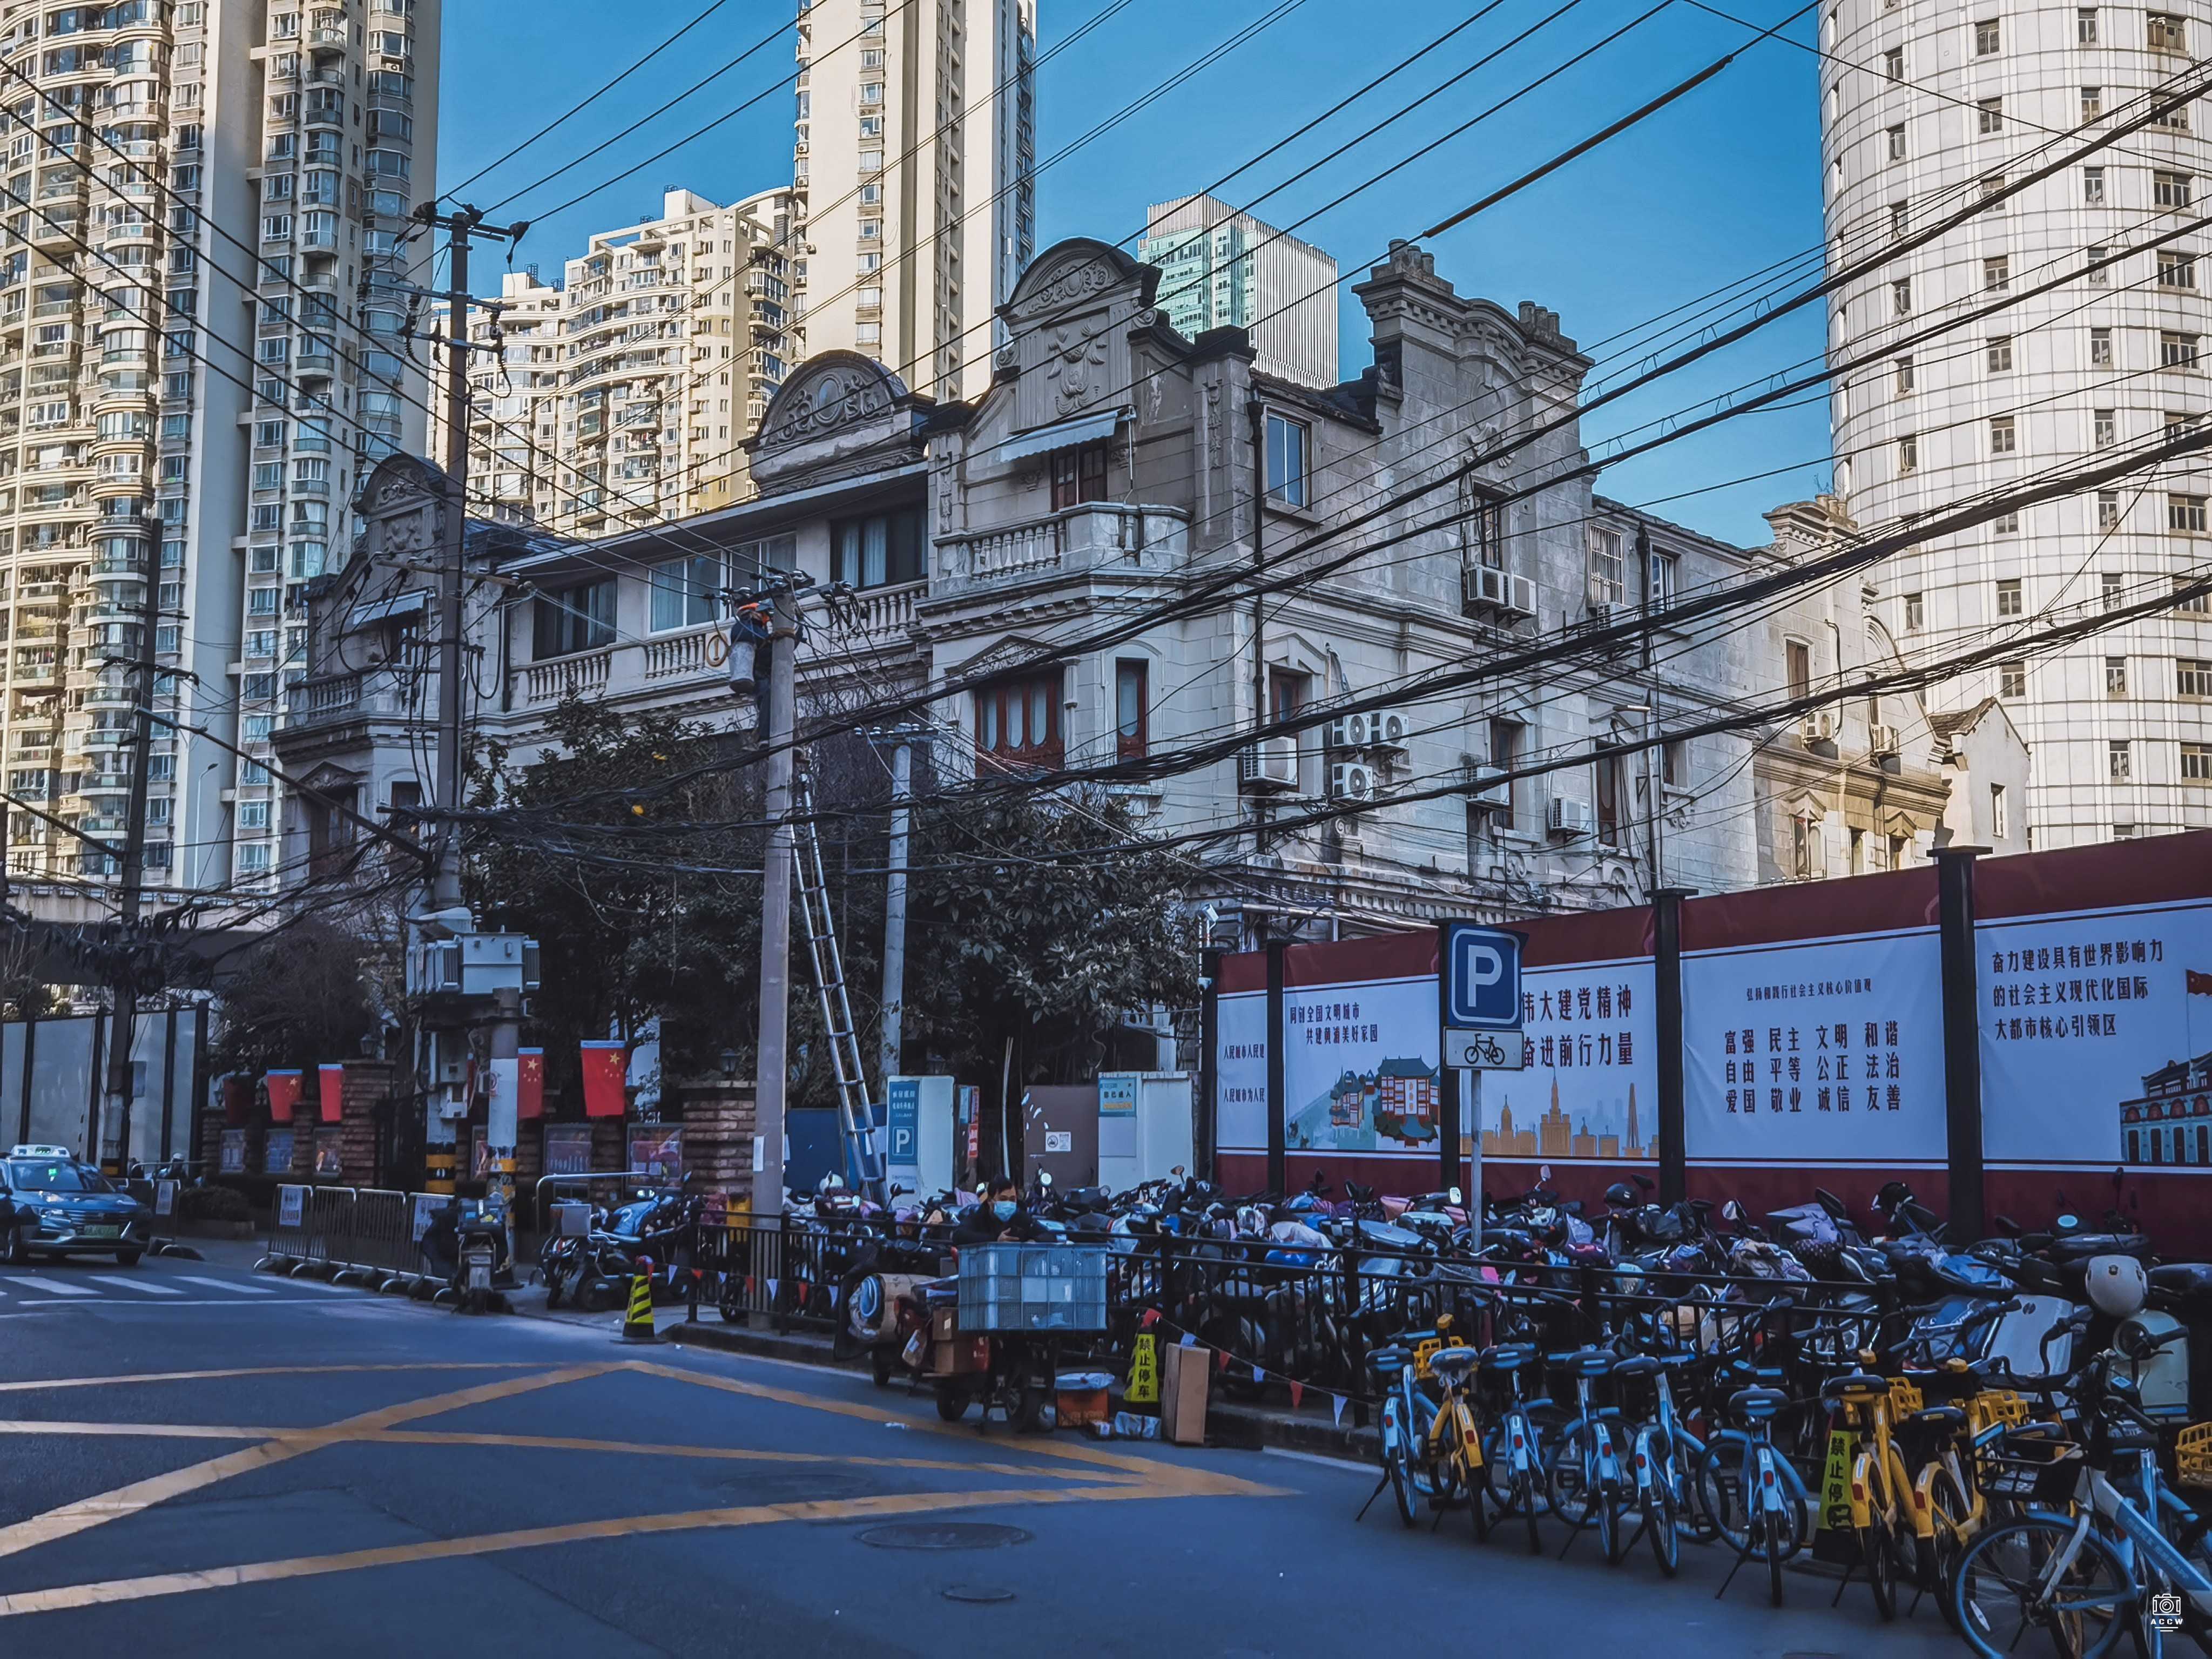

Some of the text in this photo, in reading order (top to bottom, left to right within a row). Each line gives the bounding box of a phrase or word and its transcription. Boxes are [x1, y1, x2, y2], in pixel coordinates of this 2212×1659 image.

[1992, 939, 2163, 973] 奋力建设具有世界影响力
[1468, 945, 1502, 1007] P
[1993, 976, 2148, 1007] 的社会主义现代化国际
[1290, 1002, 1359, 1024] 同创全国文明城市
[1521, 984, 1632, 1023] 伟大建党精神
[1306, 1024, 1378, 1045] 共建黄浦美好家园
[1725, 1020, 1898, 1055] 富强 民主 文明 和谐
[1995, 1014, 2116, 1040] 大都市核心引领区
[1524, 1031, 1633, 1068] 奋进前行力量
[1726, 1051, 1899, 1084] 自由 平等 公正 法治
[1726, 1084, 1901, 1114] 爱国 敬业 诚信 友善
[896, 1129, 910, 1153] P
[1138, 1338, 1151, 1399] 禁止停车
[1828, 1436, 1846, 1507] 禁止停
